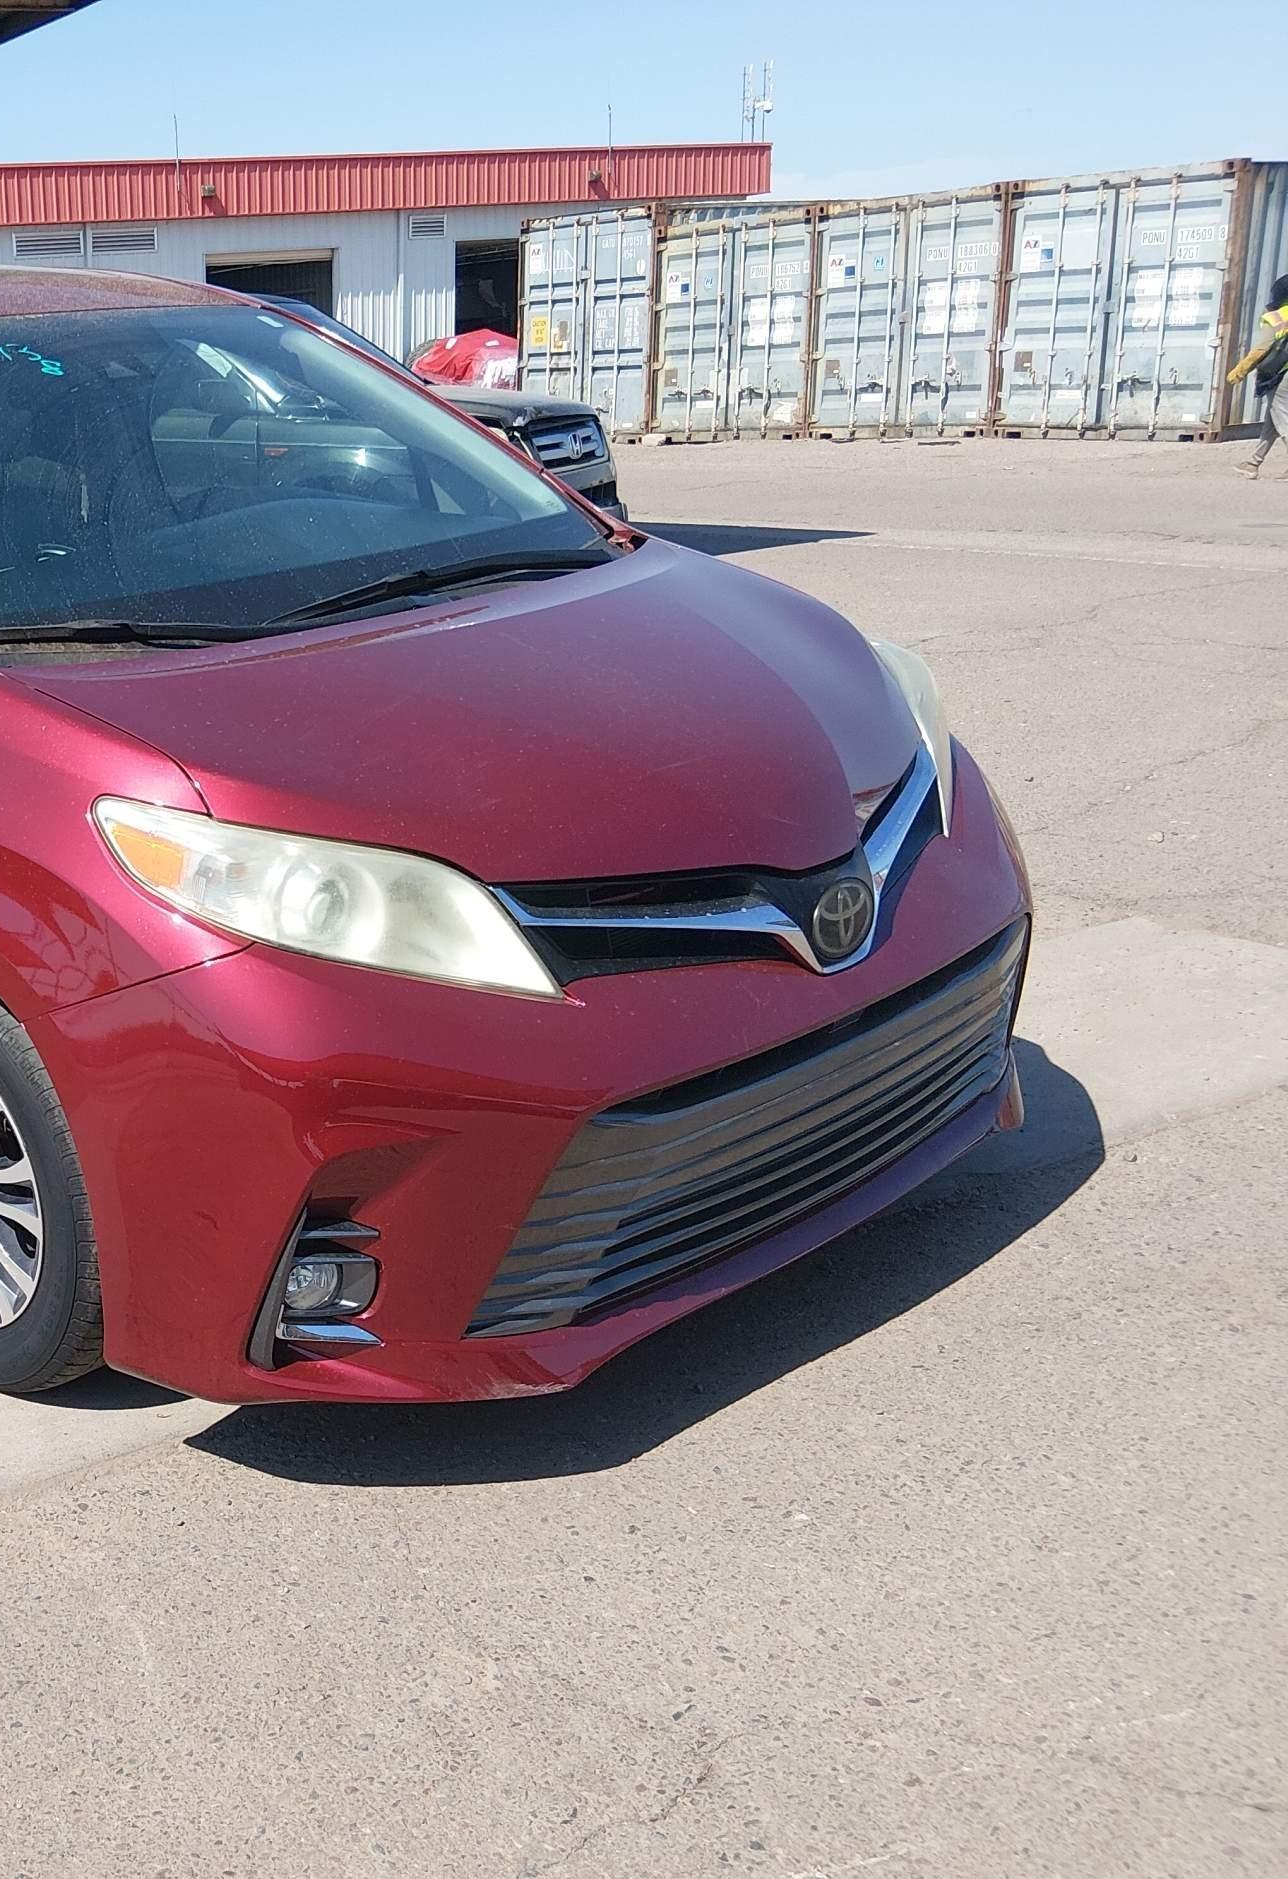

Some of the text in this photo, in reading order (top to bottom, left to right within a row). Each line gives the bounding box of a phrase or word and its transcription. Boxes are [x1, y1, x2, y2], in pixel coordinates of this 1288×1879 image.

[1142, 226, 1227, 244] PONU 174509 8
[928, 247, 949, 259] PONU
[1177, 246, 1200, 259] 42G1
